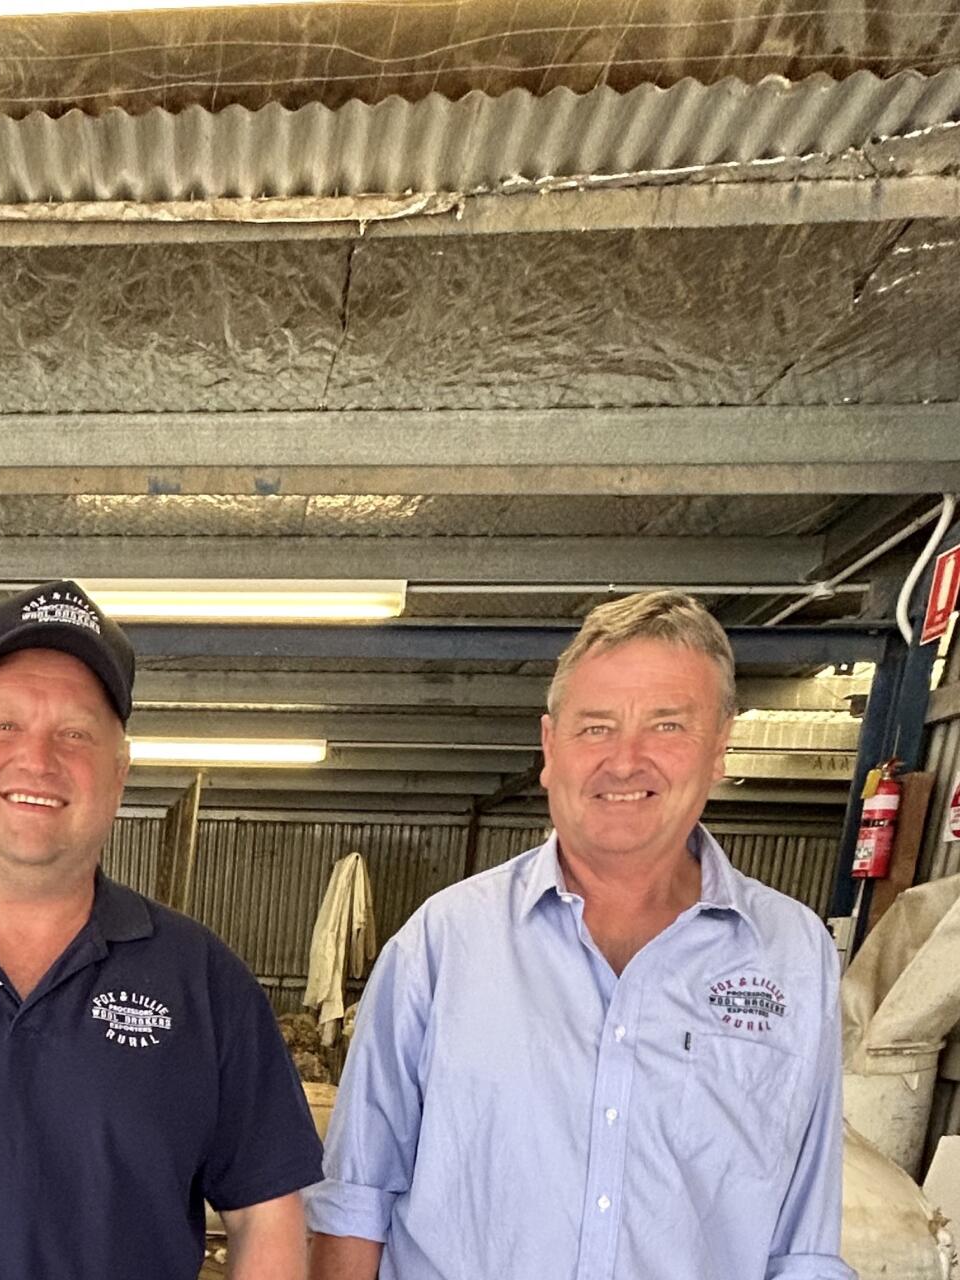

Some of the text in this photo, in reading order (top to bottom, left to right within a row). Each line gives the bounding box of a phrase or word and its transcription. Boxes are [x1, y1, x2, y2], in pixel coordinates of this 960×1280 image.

[710, 977, 785, 1002] FOX & LILLIE
[92, 991, 170, 1016] FOX & LILLIE
[709, 996, 785, 1014] WOOL BROKERS
[92, 1008, 172, 1029] WOOL BROKERS
[721, 1014, 771, 1031] RURAL
[105, 1028, 160, 1048] RURAL
